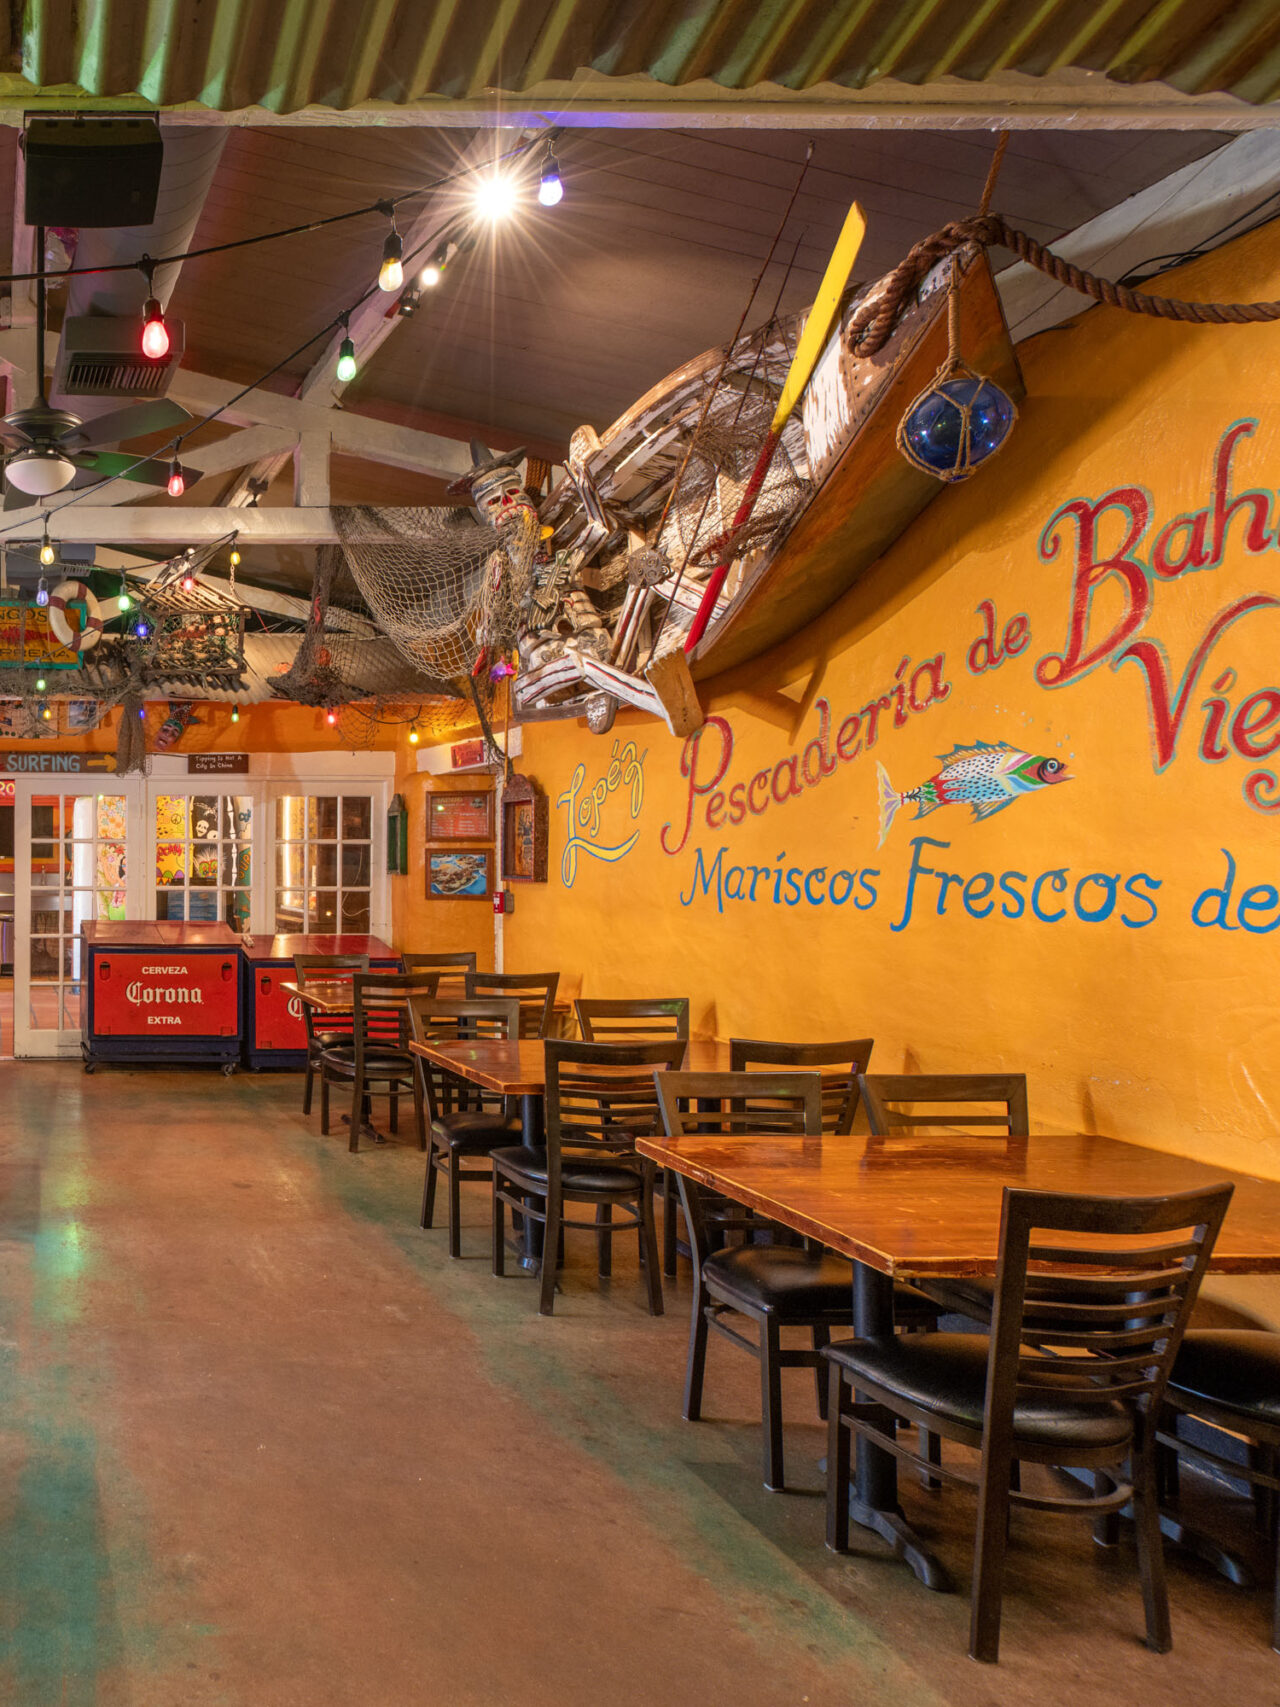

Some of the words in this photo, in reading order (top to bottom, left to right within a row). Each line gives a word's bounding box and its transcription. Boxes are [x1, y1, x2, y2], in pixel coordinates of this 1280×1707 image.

[661, 655, 952, 856] Pescadería
[966, 598, 1032, 675] de
[1034, 417, 1280, 690] Bah
[6, 755, 81, 772] SURFING
[890, 836, 1163, 933] Frescos
[1191, 848, 1280, 934] de
[141, 966, 188, 975] CERVEZA
[126, 981, 204, 1006] Corona
[147, 1016, 182, 1025] EXTRA
